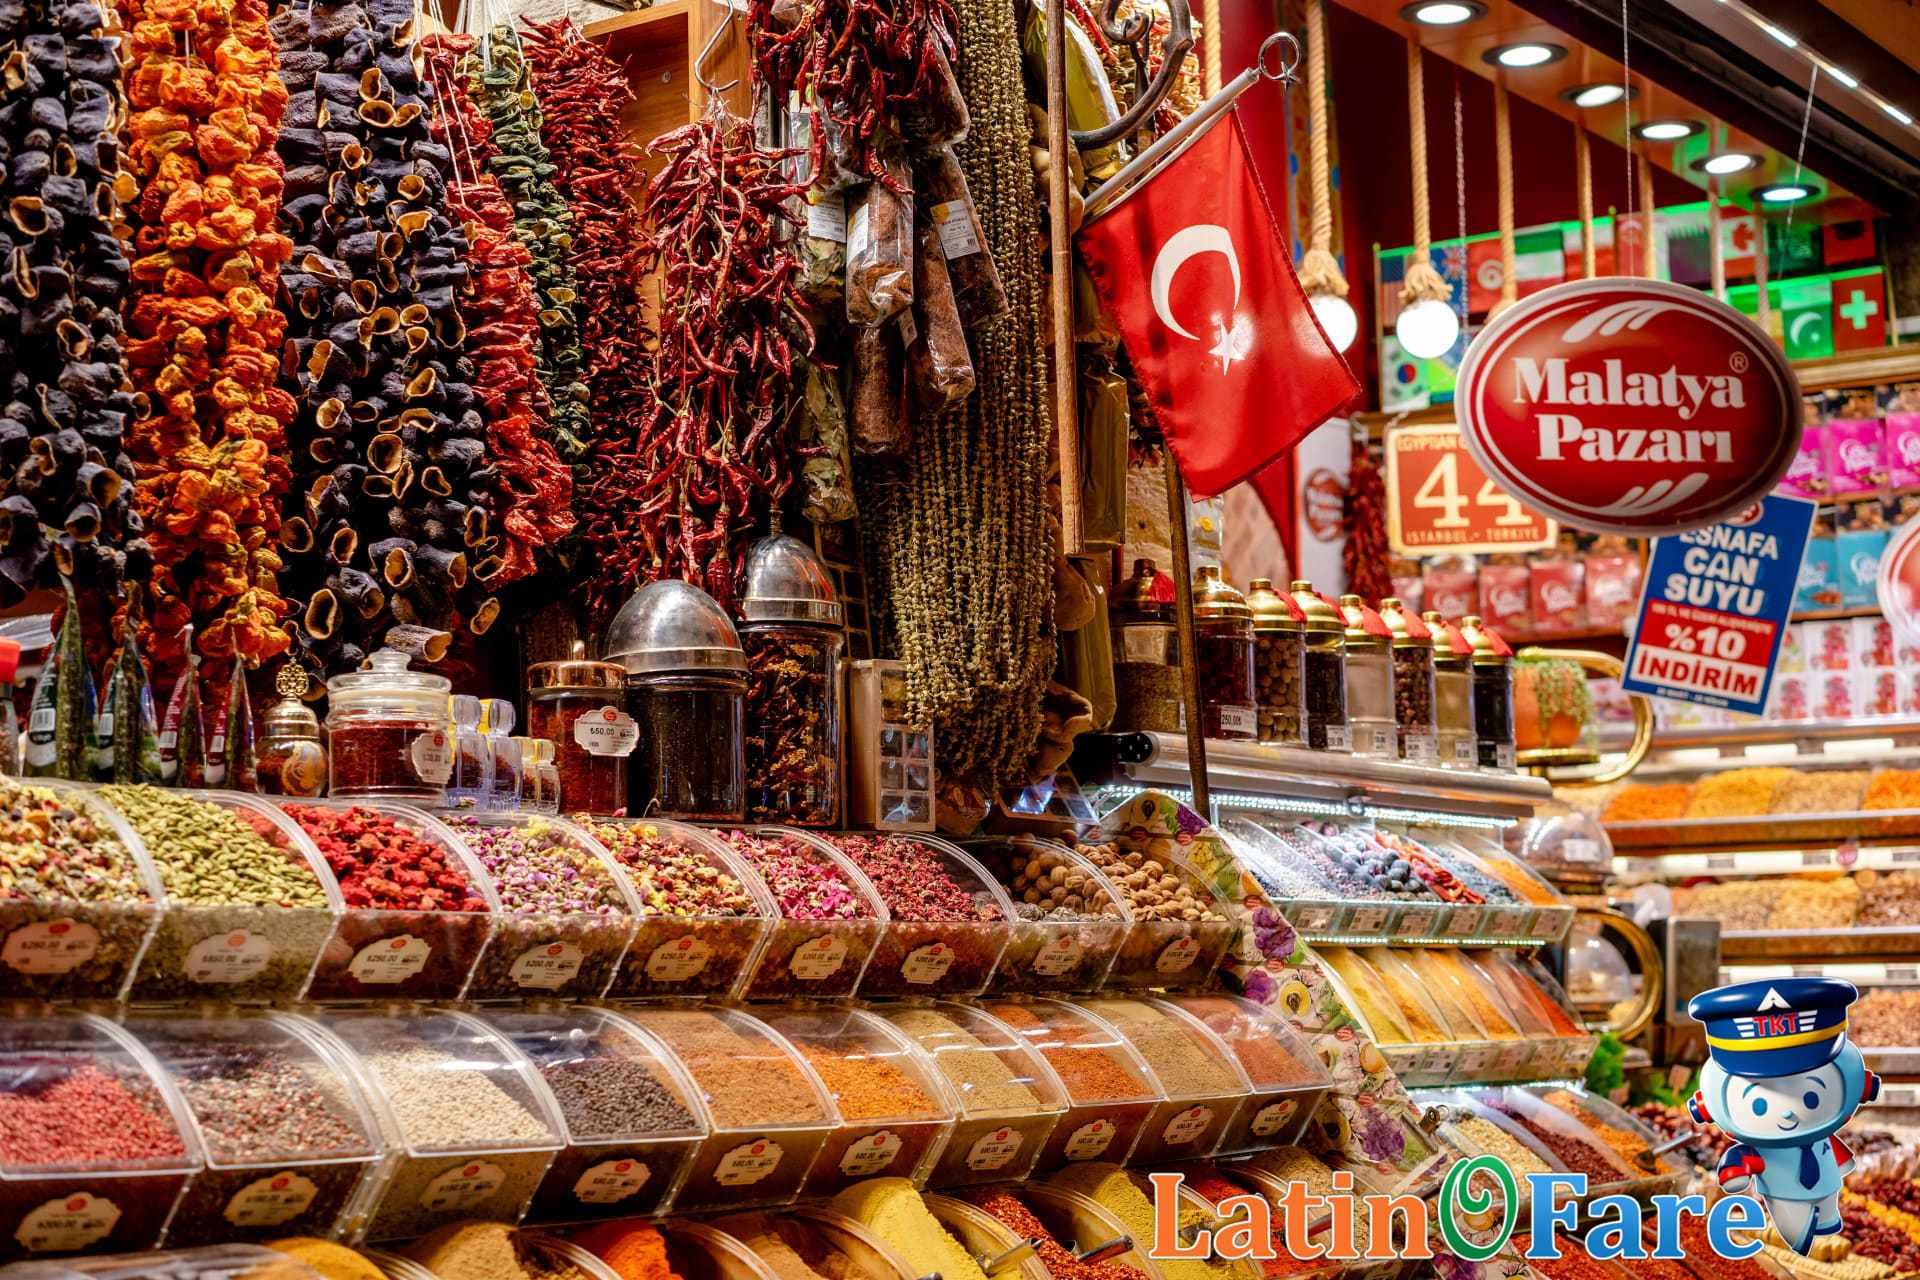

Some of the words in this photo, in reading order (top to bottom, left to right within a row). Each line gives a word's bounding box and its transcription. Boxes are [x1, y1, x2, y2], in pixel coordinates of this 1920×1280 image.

[1511, 357, 1746, 420] Malatya
[1534, 414, 1734, 463] Pazarı
[1414, 452, 1533, 528] 44
[1679, 525, 1778, 560] ESNAFA
[1683, 547, 1760, 586] CAN
[1664, 573, 1765, 616] SUYU
[1665, 623, 1746, 661] %10
[1637, 649, 1758, 696] İNDİRİM
